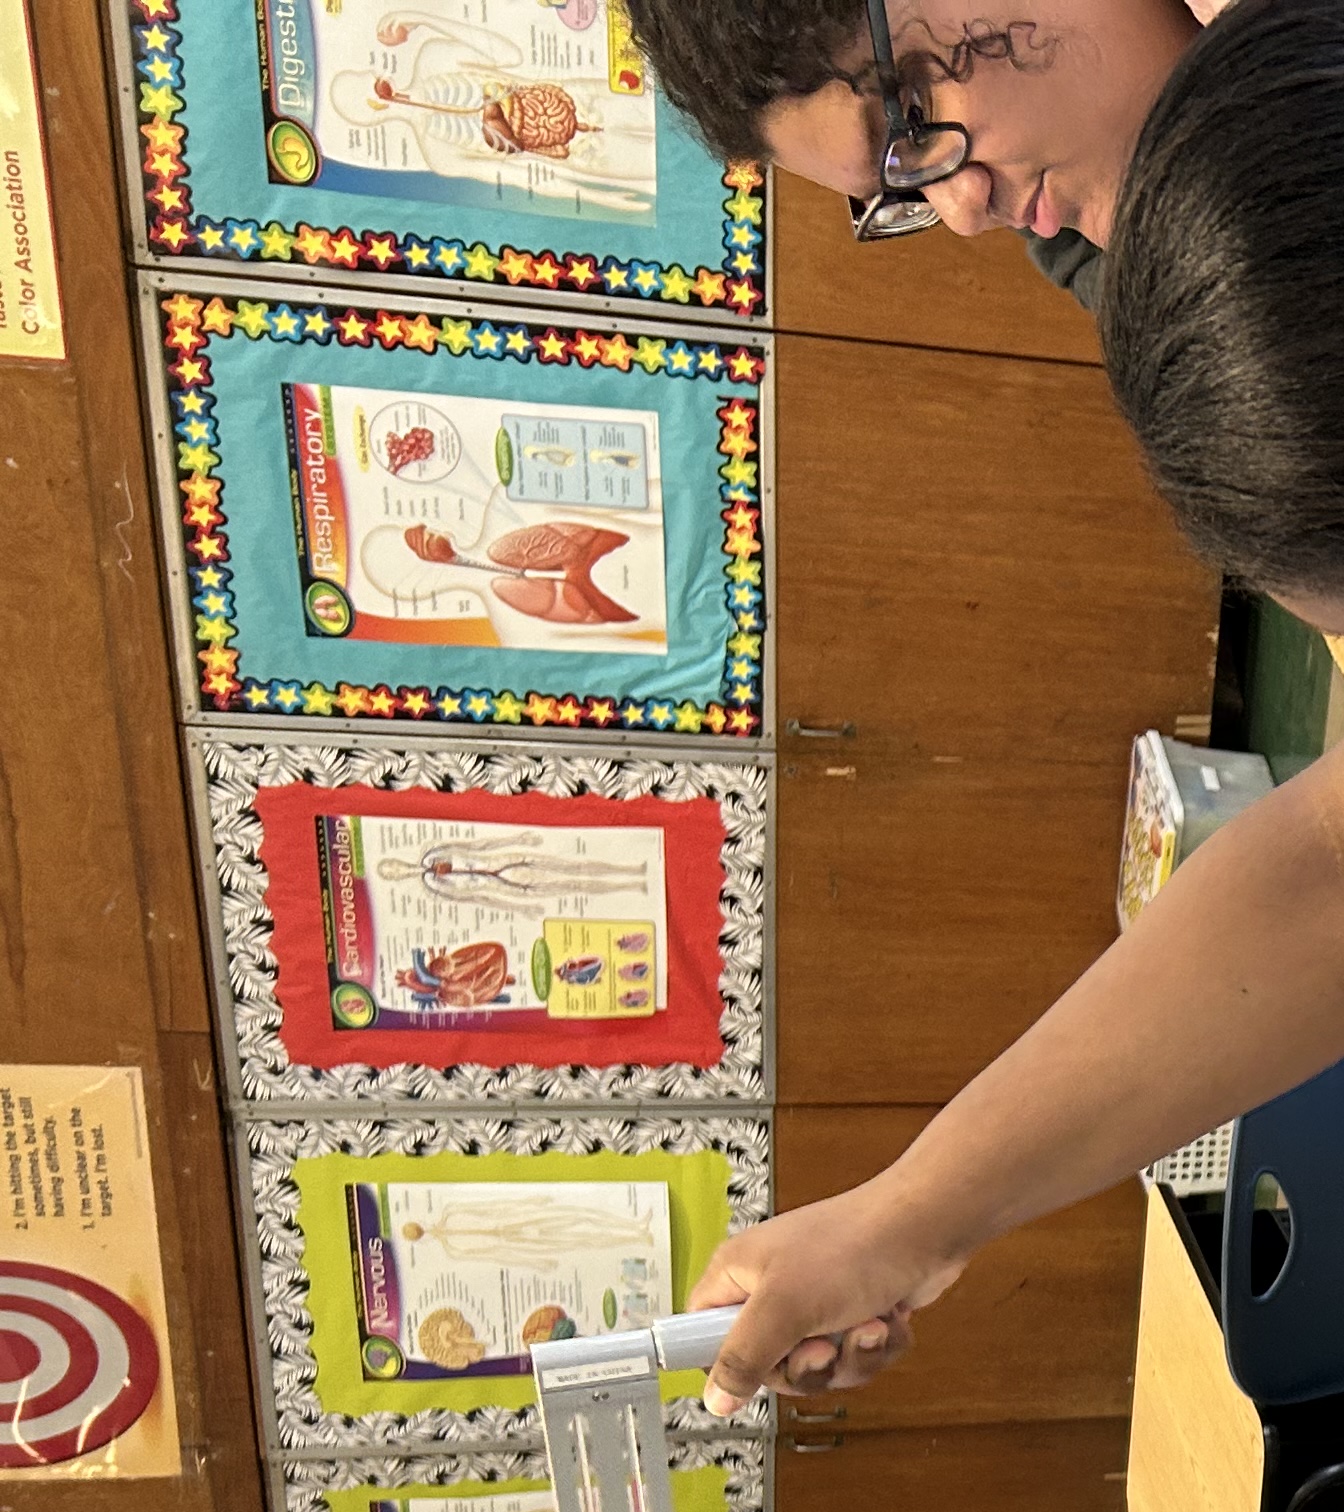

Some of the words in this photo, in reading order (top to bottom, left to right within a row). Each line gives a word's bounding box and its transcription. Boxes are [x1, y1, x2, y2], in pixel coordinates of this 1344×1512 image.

[259, 24, 267, 65] Human
[3, 150, 33, 273] Association
[304, 408, 336, 572] Respiratory
[293, 497, 303, 535] Human
[332, 820, 361, 976] Cardiovascular
[0, 1088, 14, 1127] target
[19, 1097, 33, 1119] still
[69, 1108, 82, 1127] the
[4, 1131, 17, 1151] the
[23, 1123, 36, 1144] but
[73, 1131, 84, 1147] on
[9, 1154, 22, 1195] hitting
[74, 1151, 89, 1195] unclear
[94, 1154, 107, 1173] I'm
[13, 1198, 25, 1217] I'm
[50, 1177, 64, 1217] having
[80, 1198, 93, 1217] I'm
[368, 1237, 391, 1328] Nervous
